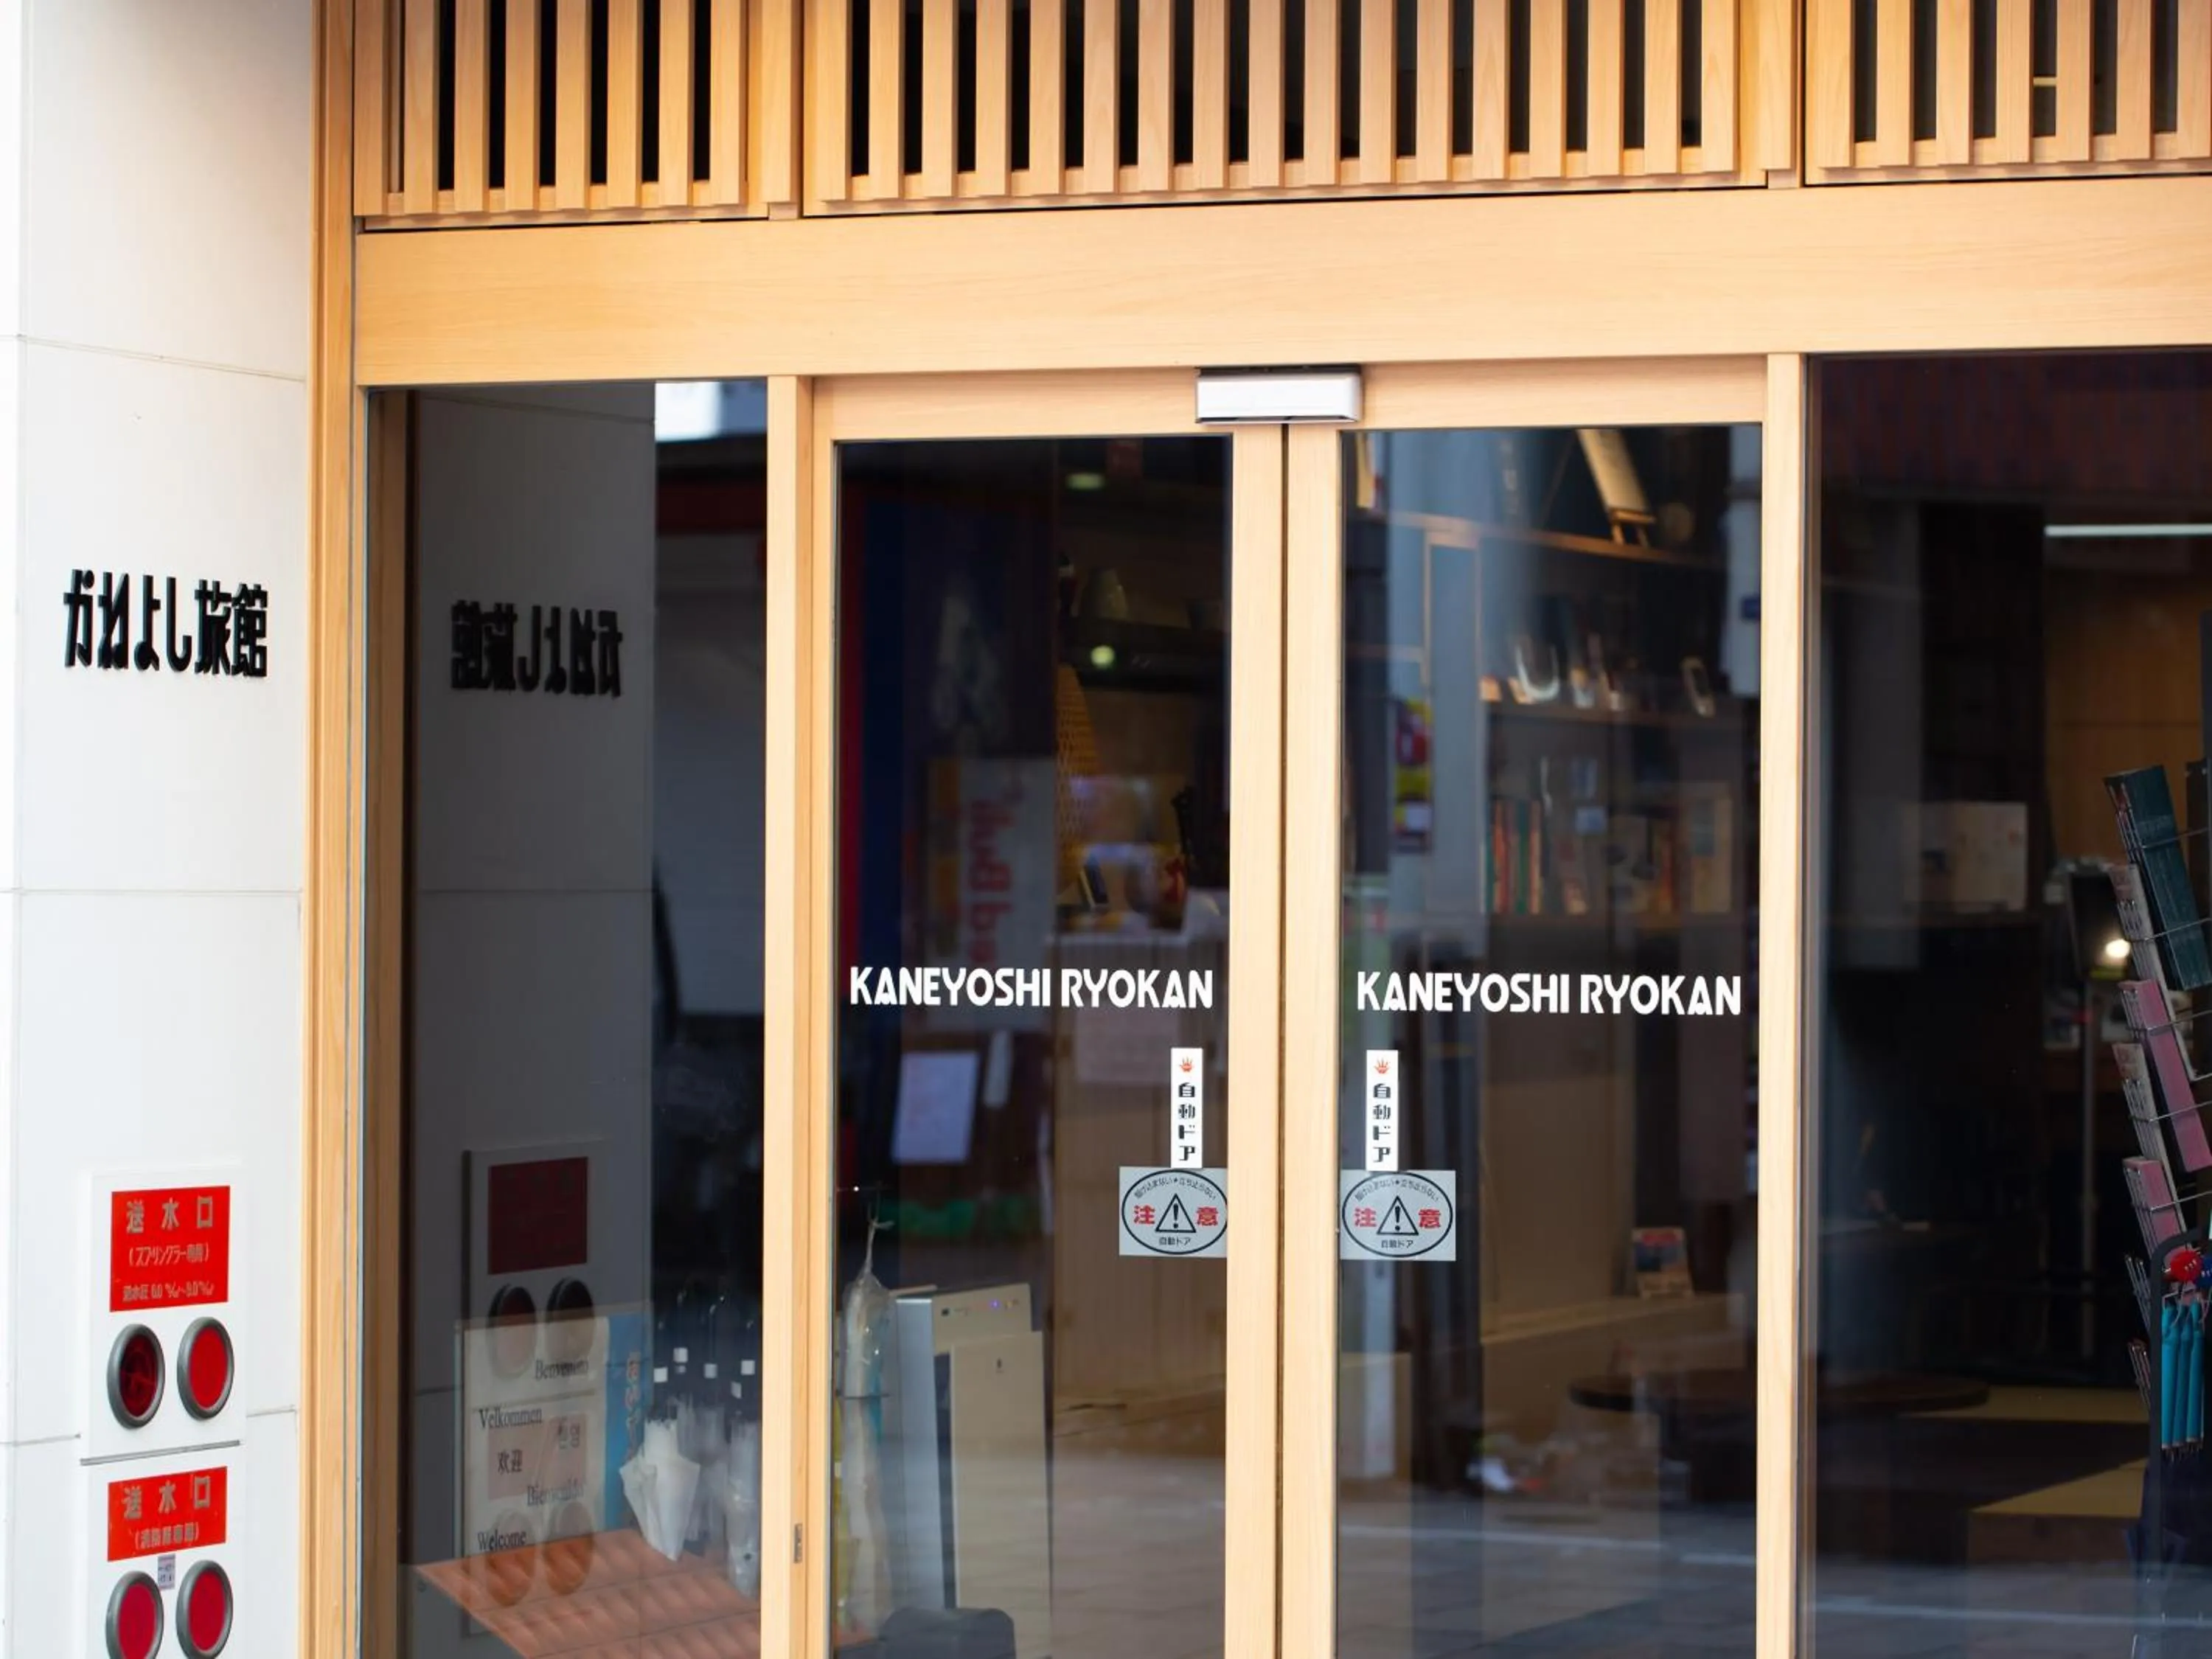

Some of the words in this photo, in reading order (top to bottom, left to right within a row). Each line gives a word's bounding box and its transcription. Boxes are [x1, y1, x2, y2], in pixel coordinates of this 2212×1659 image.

[63, 568, 268, 678] かねよし旅館
[850, 967, 1051, 1006] KANEYOSHI
[1061, 968, 1213, 1009] RYOKAN
[1357, 971, 1570, 1014] KANEYOSHI
[1580, 974, 1741, 1015] RYOKAN
[1178, 1082, 1195, 1161] 自動ドア
[1373, 1082, 1391, 1163] 自動ドア
[479, 1407, 542, 1430] Velkommen
[477, 1528, 527, 1551] Welcome
